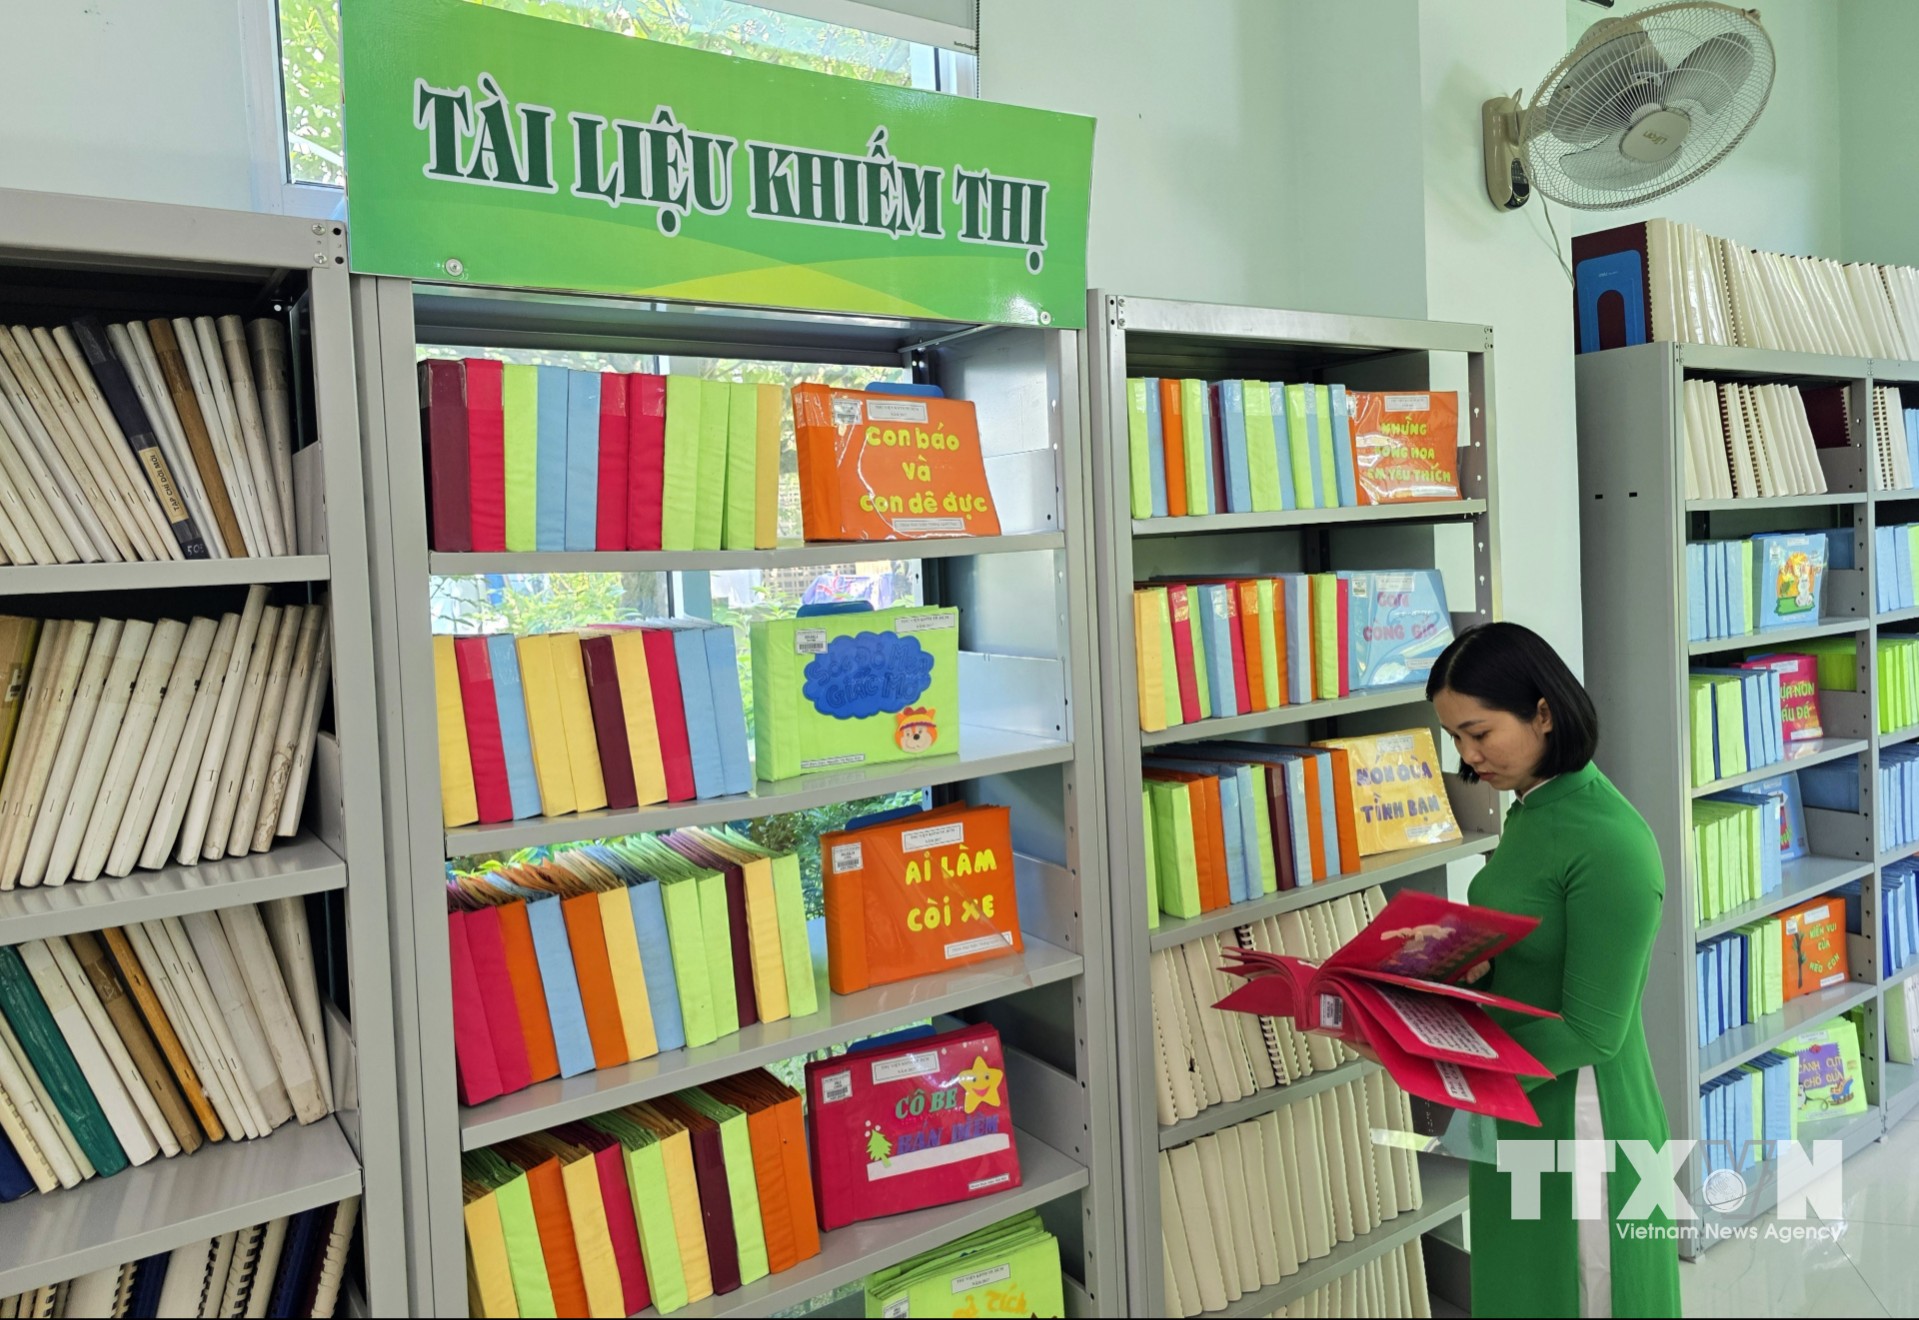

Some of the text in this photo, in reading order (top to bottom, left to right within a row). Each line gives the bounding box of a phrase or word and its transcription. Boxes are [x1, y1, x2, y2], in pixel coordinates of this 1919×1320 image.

[414, 71, 1049, 275] TÀI LIỆU KHIẾM THỊ
[909, 491, 938, 514] dê
[943, 492, 988, 520] đực
[940, 844, 998, 878] LÀM
[961, 894, 995, 923] XE
[895, 1088, 925, 1119] CÔ
